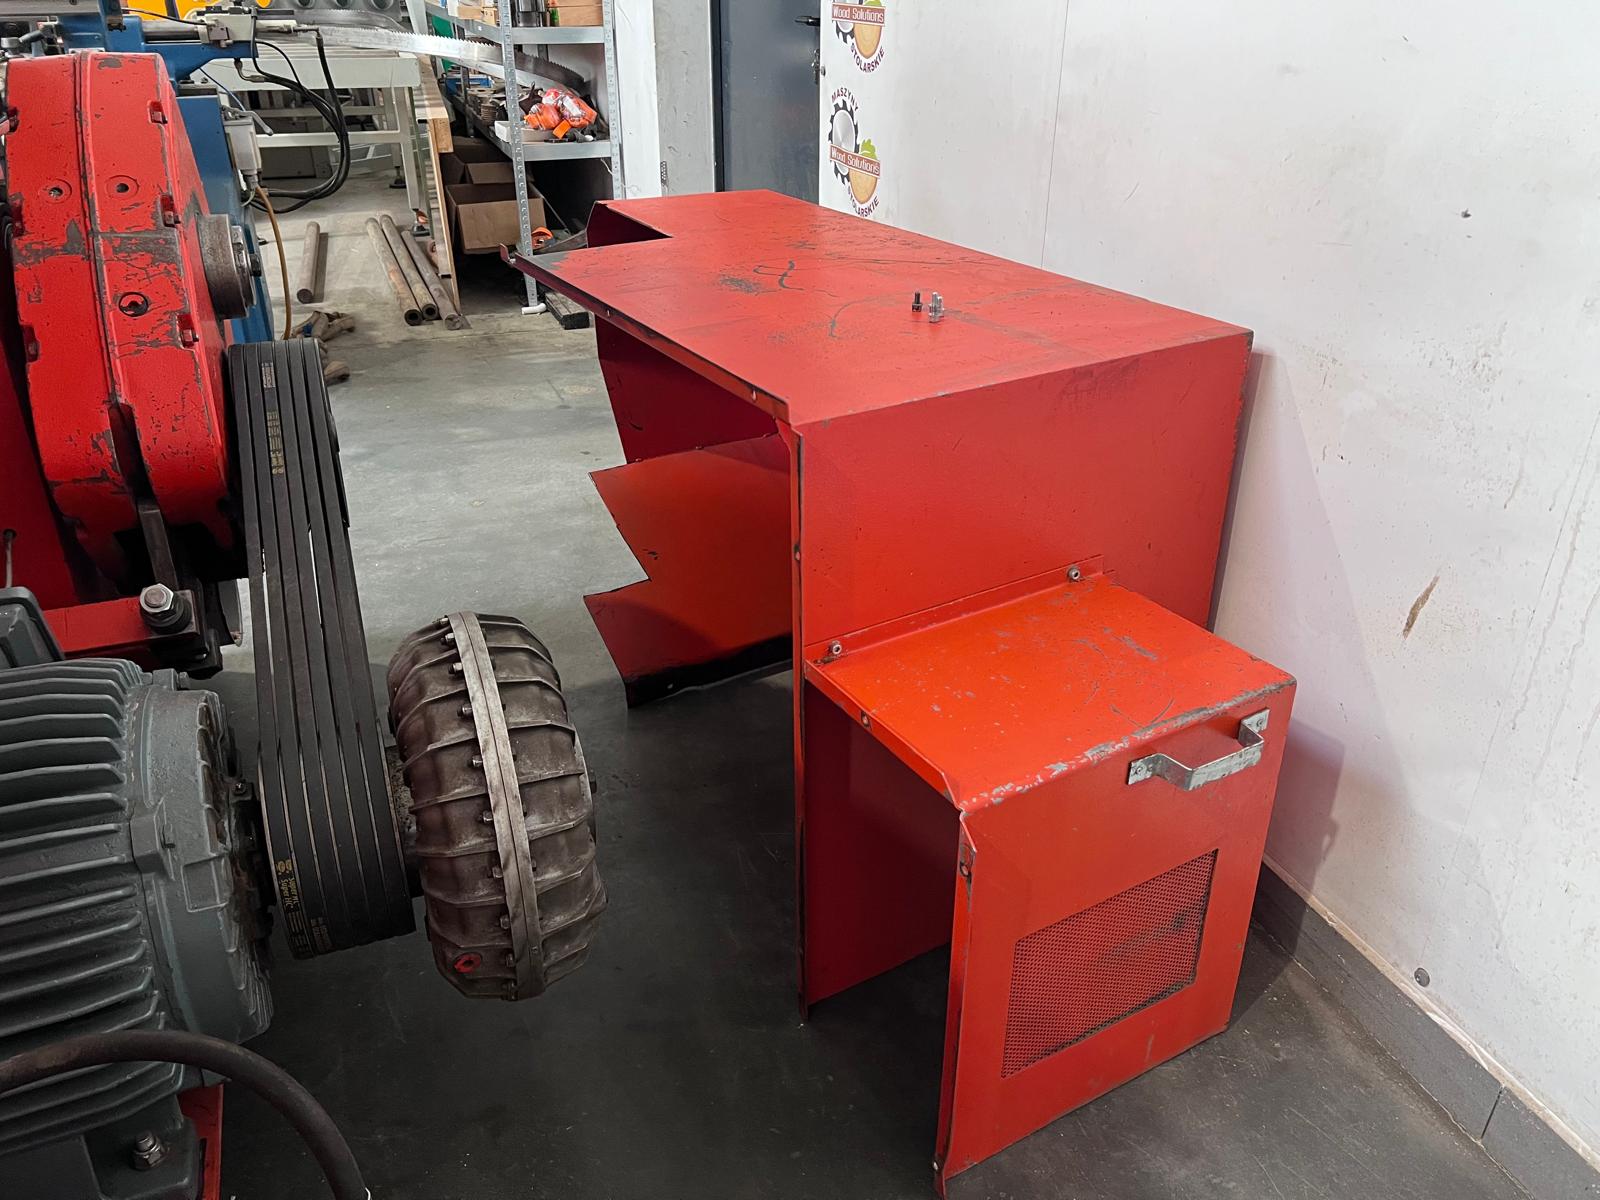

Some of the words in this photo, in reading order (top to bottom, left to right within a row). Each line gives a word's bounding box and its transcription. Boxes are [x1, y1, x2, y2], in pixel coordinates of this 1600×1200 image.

[833, 6, 850, 19] Wood
[852, 7, 884, 23] Solutions
[850, 43, 885, 73] STOLARSKIE
[831, 87, 859, 111] MASZYNY
[831, 147, 846, 163] Wood
[847, 155, 880, 175] Solutions
[847, 185, 880, 217] STOLARSKIE
